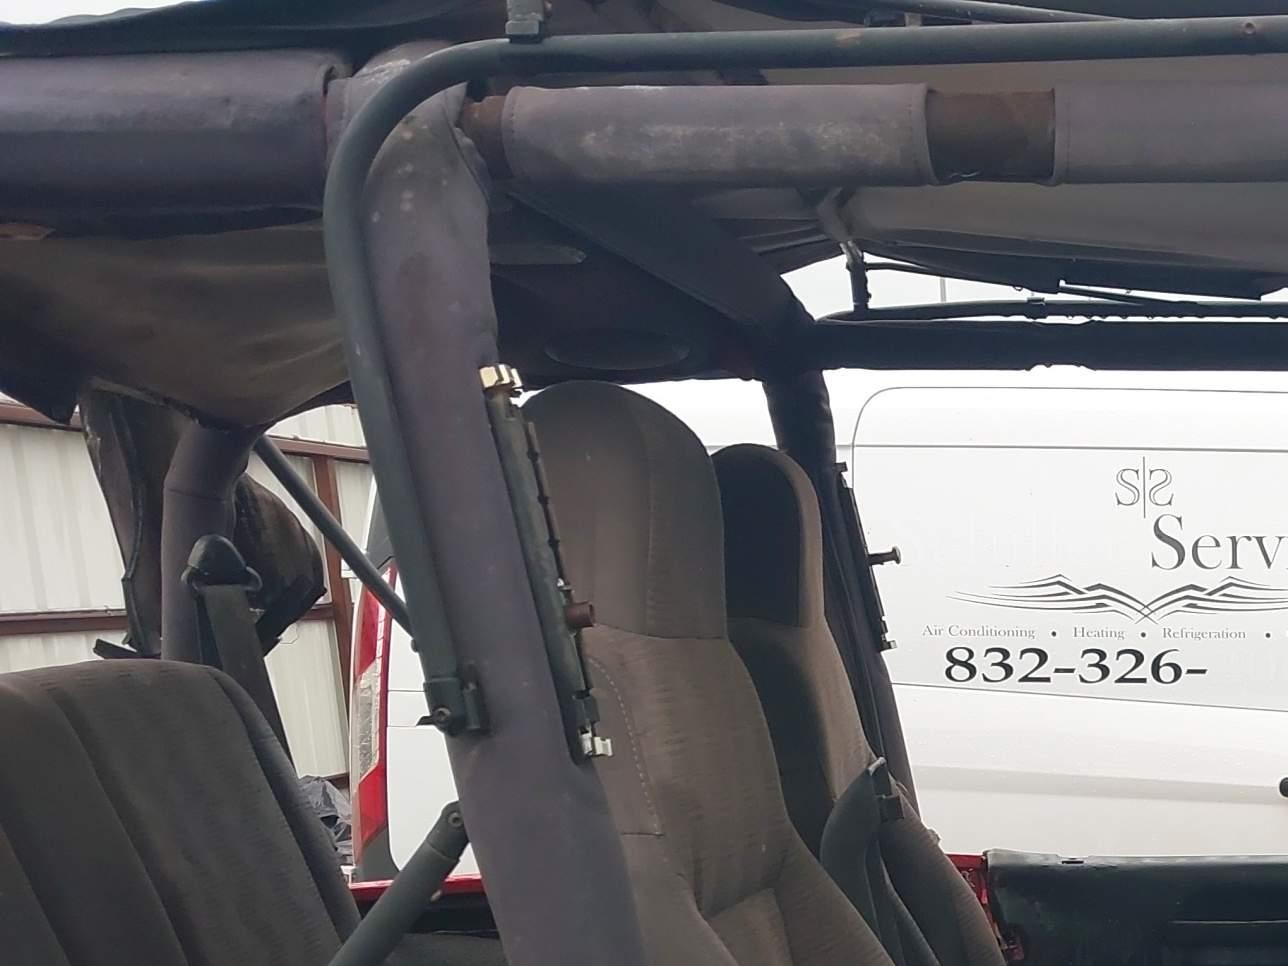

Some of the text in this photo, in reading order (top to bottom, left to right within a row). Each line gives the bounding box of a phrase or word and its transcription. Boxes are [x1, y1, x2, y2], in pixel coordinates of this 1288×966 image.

[922, 624, 944, 637] Air
[948, 624, 1036, 641] Conditioning
[1073, 625, 1125, 641] Heating
[1162, 626, 1246, 642] Refrigeration
[943, 646, 1208, 685] 832-326-
